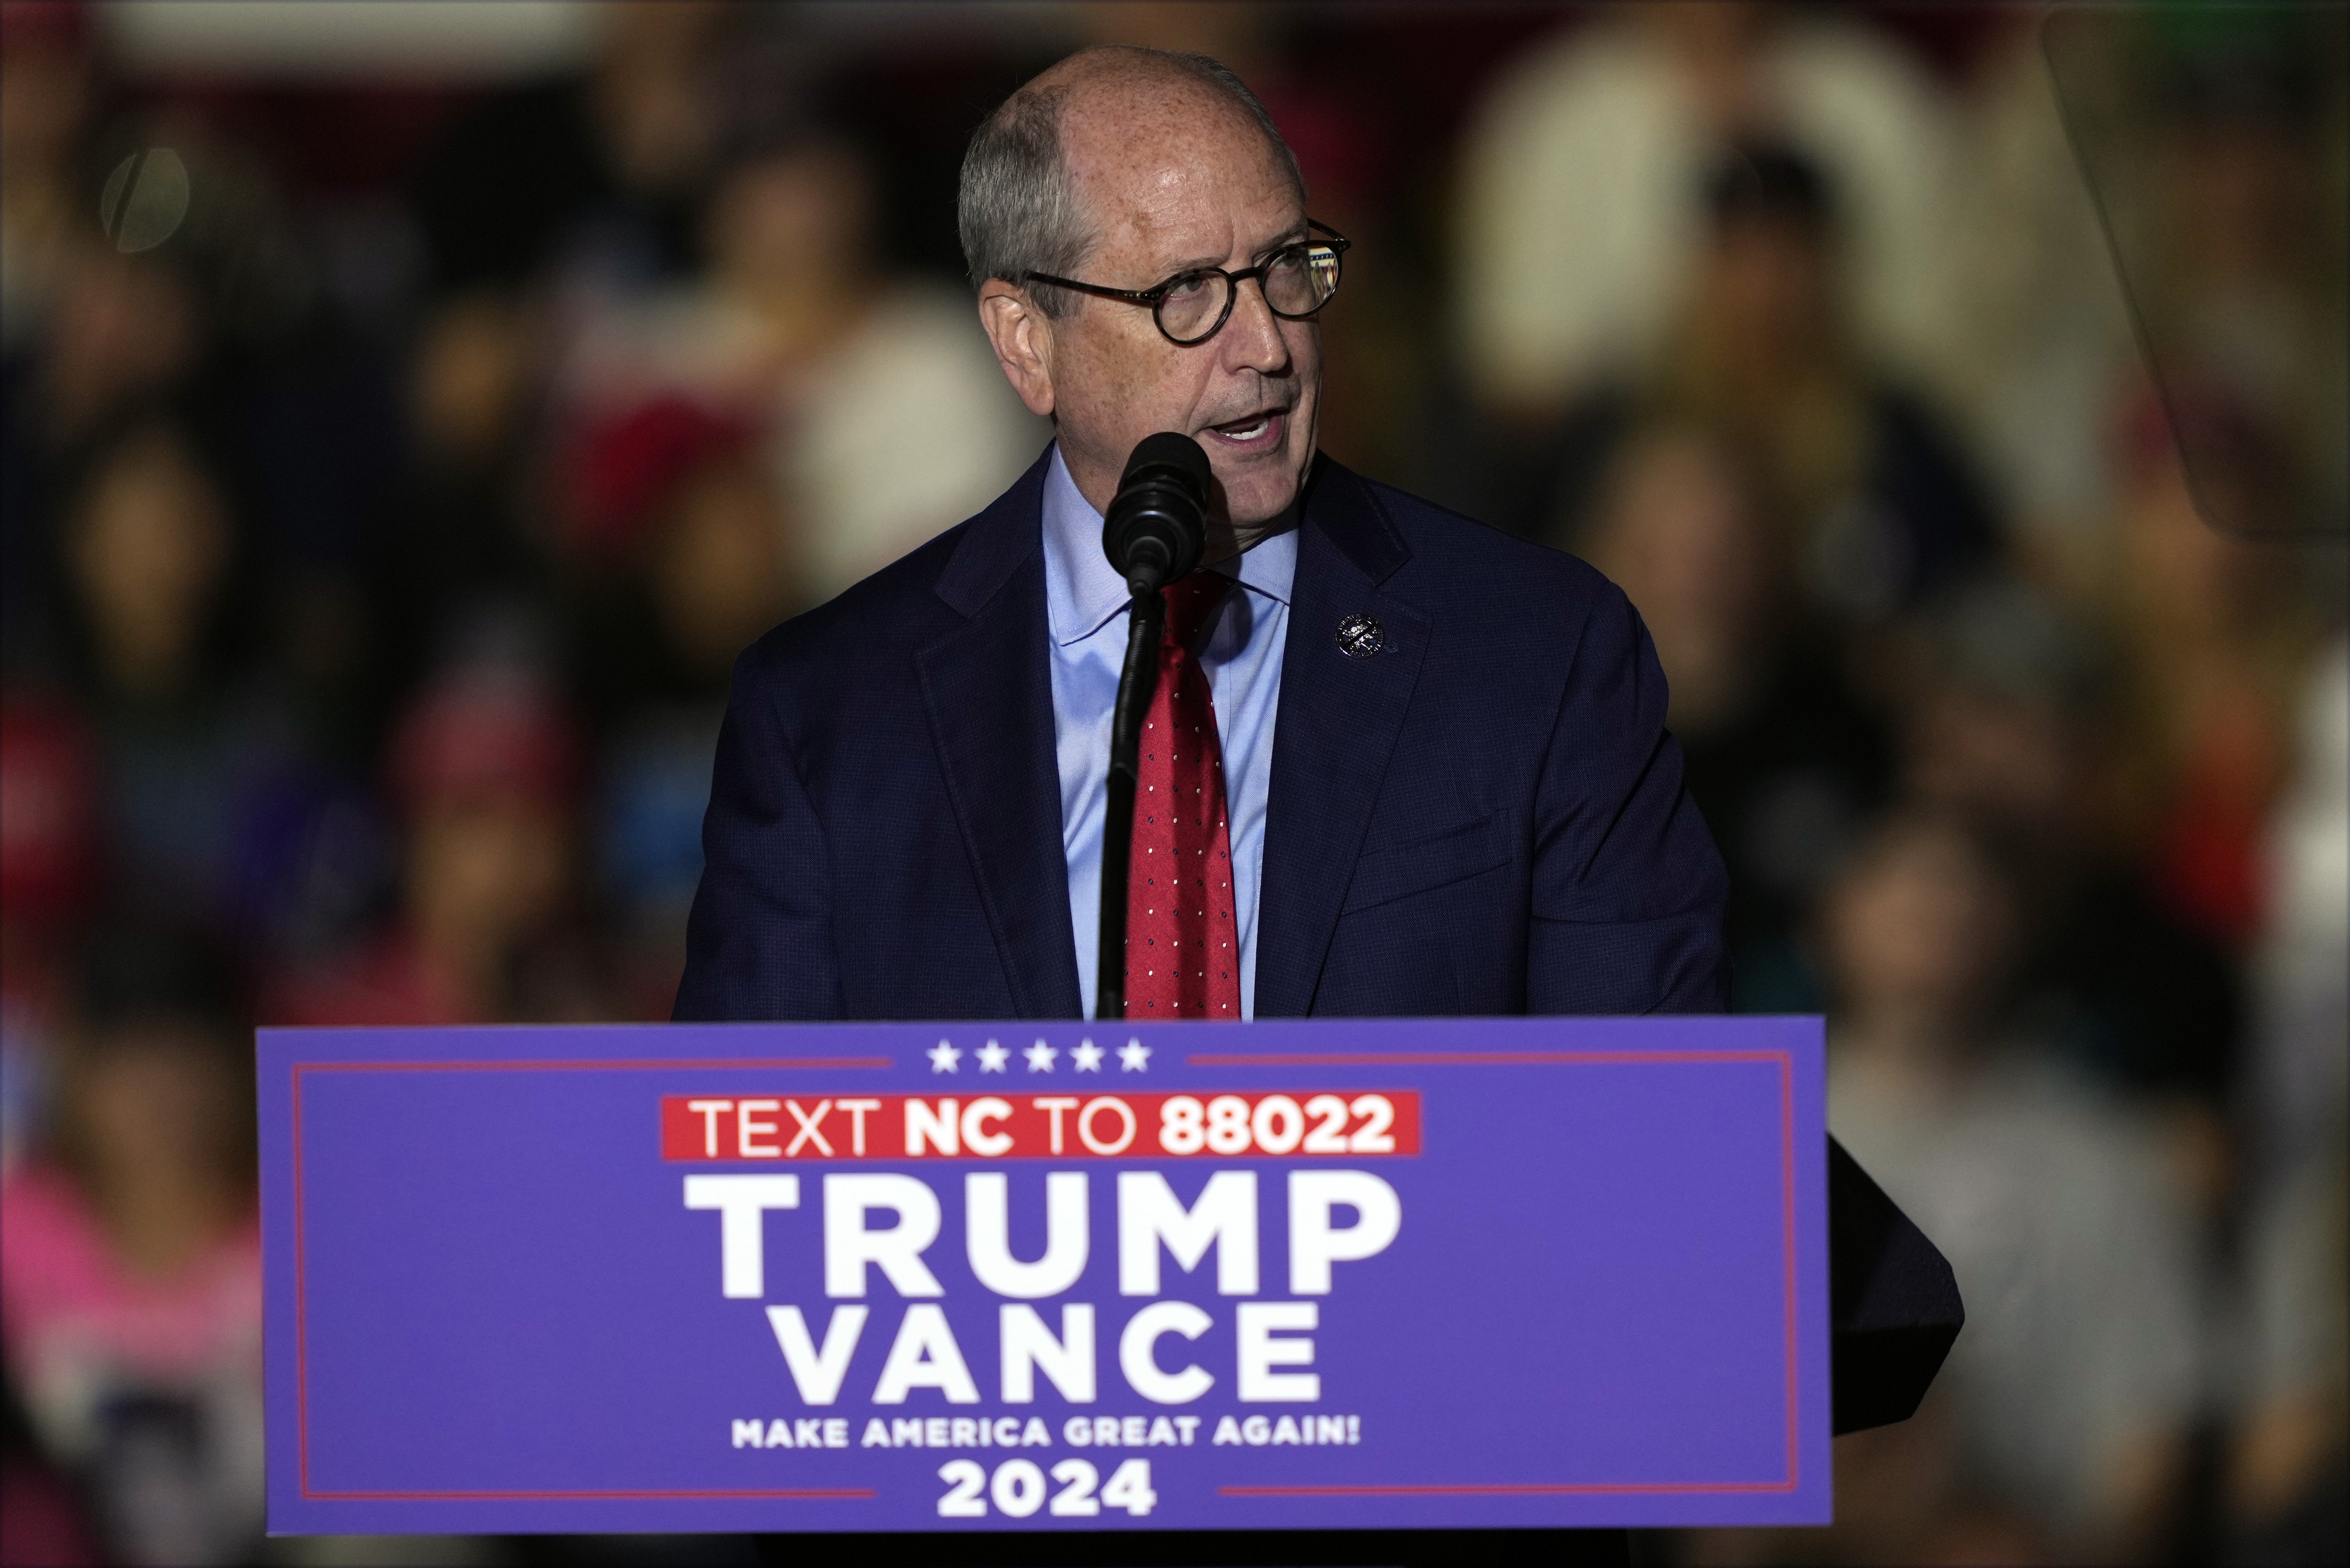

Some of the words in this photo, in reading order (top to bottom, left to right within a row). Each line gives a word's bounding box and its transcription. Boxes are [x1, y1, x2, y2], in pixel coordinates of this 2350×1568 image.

[687, 1099, 882, 1158] TEXT
[904, 1097, 1014, 1157] NC
[1033, 1096, 1137, 1155] TO
[1158, 1094, 1396, 1154] 88022
[683, 1169, 1402, 1299] TRUMP
[765, 1301, 1321, 1406] VANCE
[731, 1418, 849, 1448] MAKE
[861, 1417, 1052, 1448] AMERICA
[1063, 1415, 1201, 1446] GREAT
[1212, 1415, 1360, 1446] AGAIN!
[937, 1458, 1157, 1518] 2024
